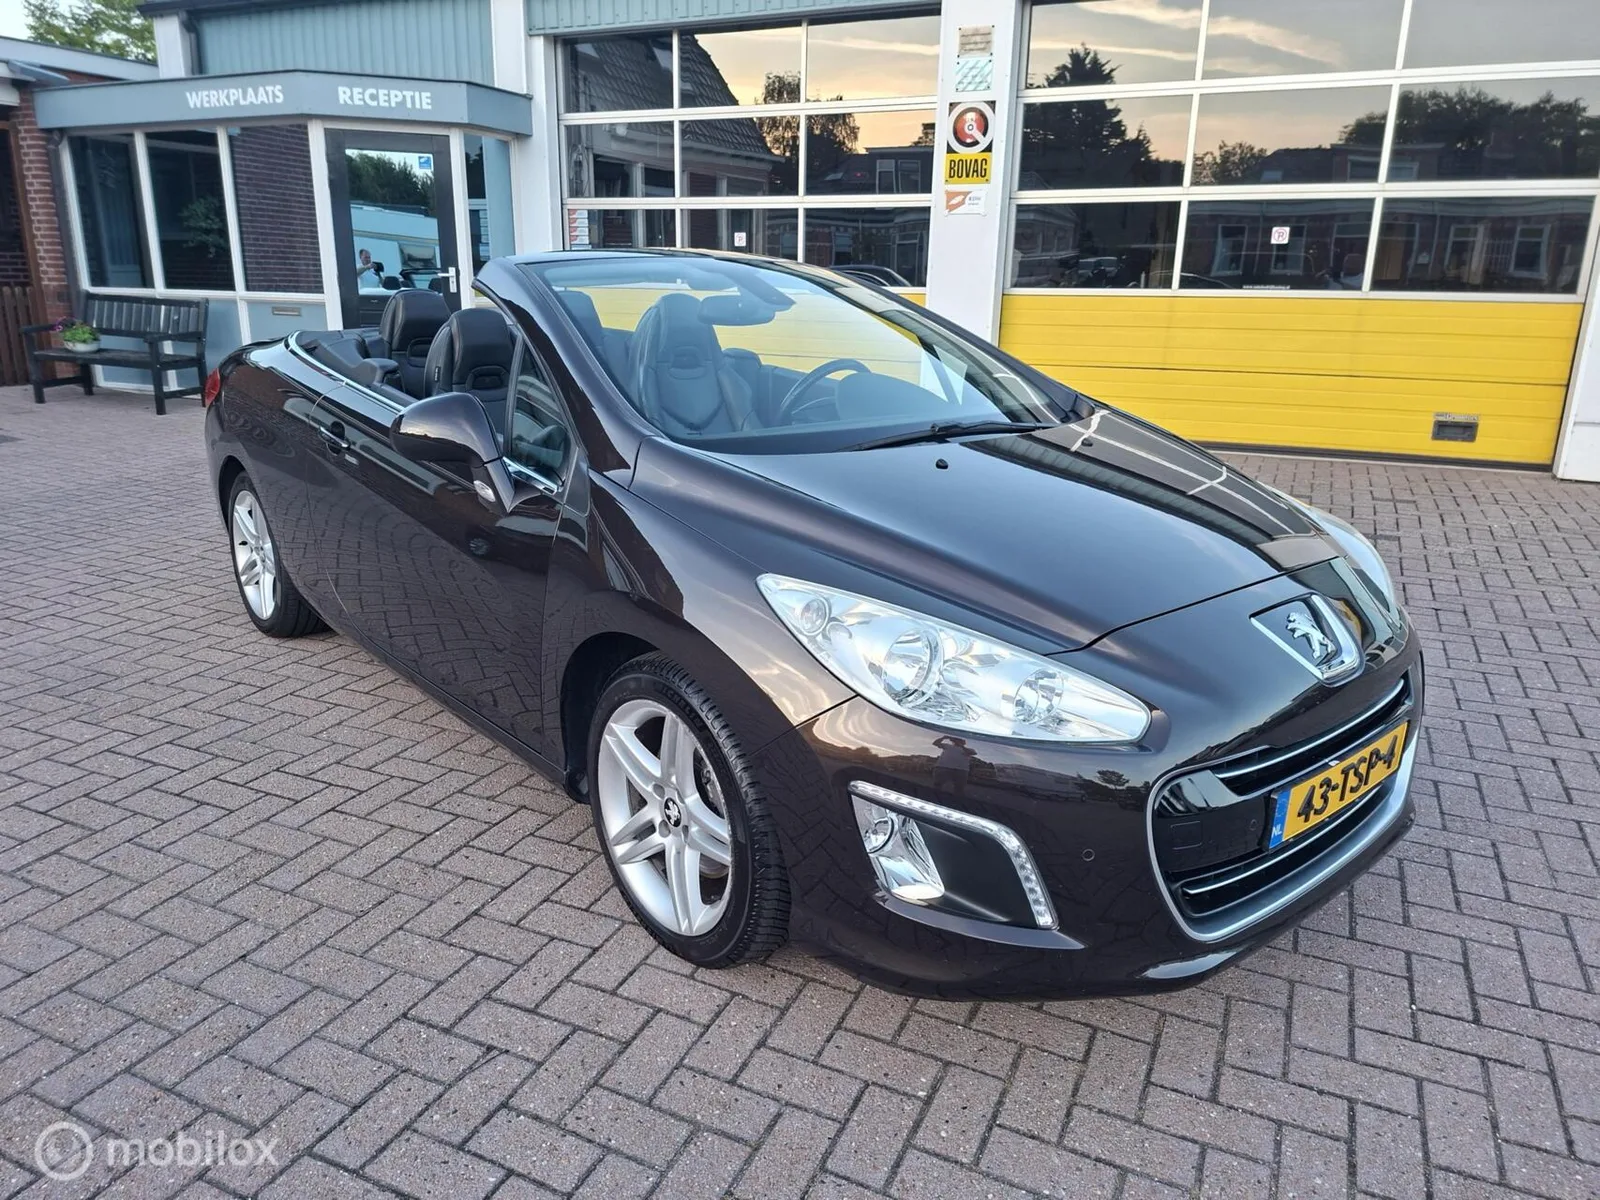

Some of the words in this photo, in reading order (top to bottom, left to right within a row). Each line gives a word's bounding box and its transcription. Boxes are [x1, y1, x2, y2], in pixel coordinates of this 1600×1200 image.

[186, 85, 284, 108] WERKPLAATS
[338, 86, 432, 110] RECEPTIE
[949, 158, 988, 179] BOVAG
[1297, 734, 1398, 823] 43-TSP-4
[1271, 823, 1283, 838] NL
